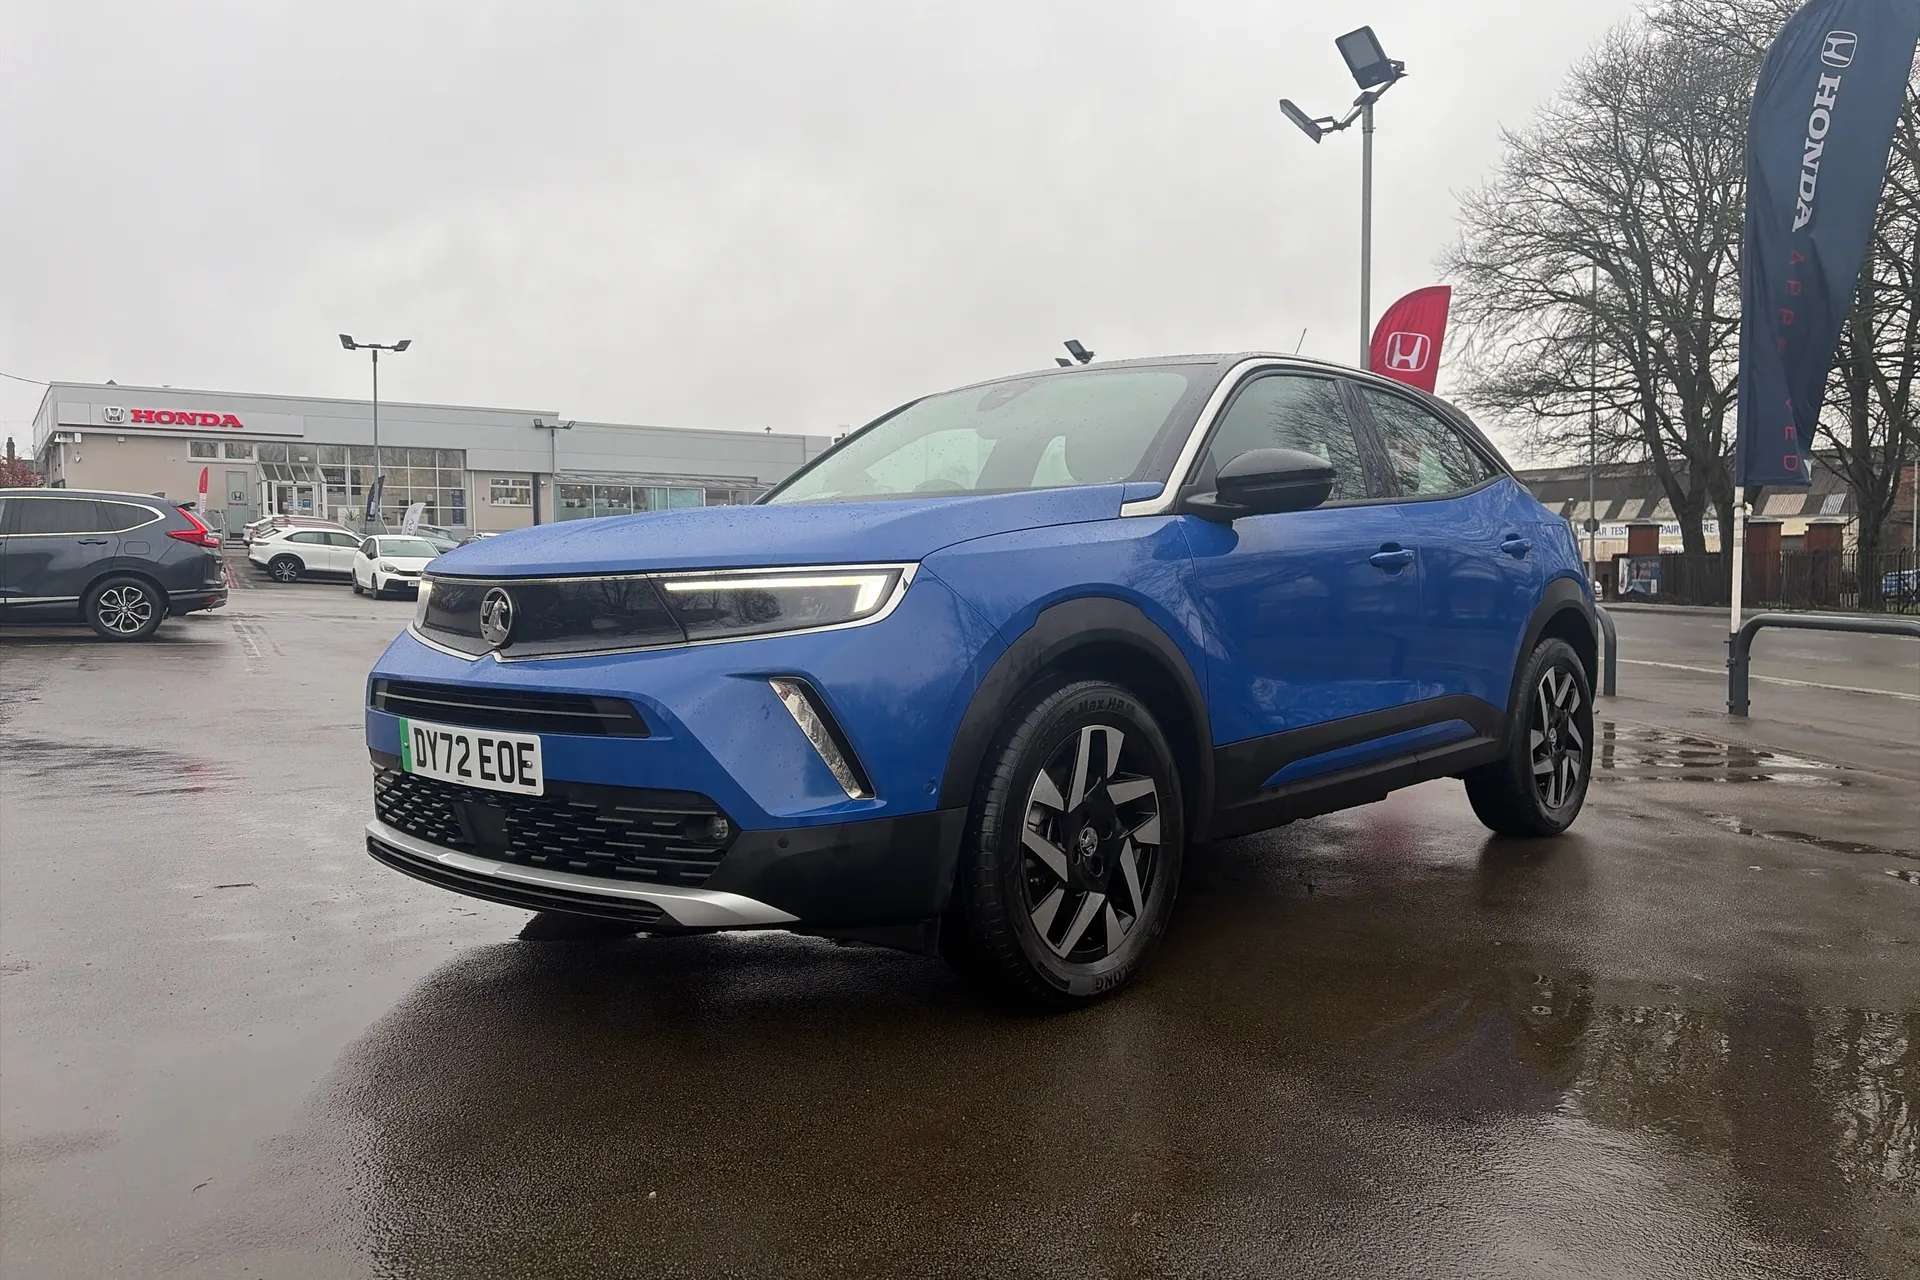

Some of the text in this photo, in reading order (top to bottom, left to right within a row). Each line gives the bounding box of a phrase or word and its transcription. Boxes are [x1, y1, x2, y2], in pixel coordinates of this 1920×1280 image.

[1792, 72, 1841, 233] HONDA
[130, 409, 244, 428] HONDA
[1661, 524, 1680, 535] PAIR
[413, 727, 537, 787] DY72 EOE
